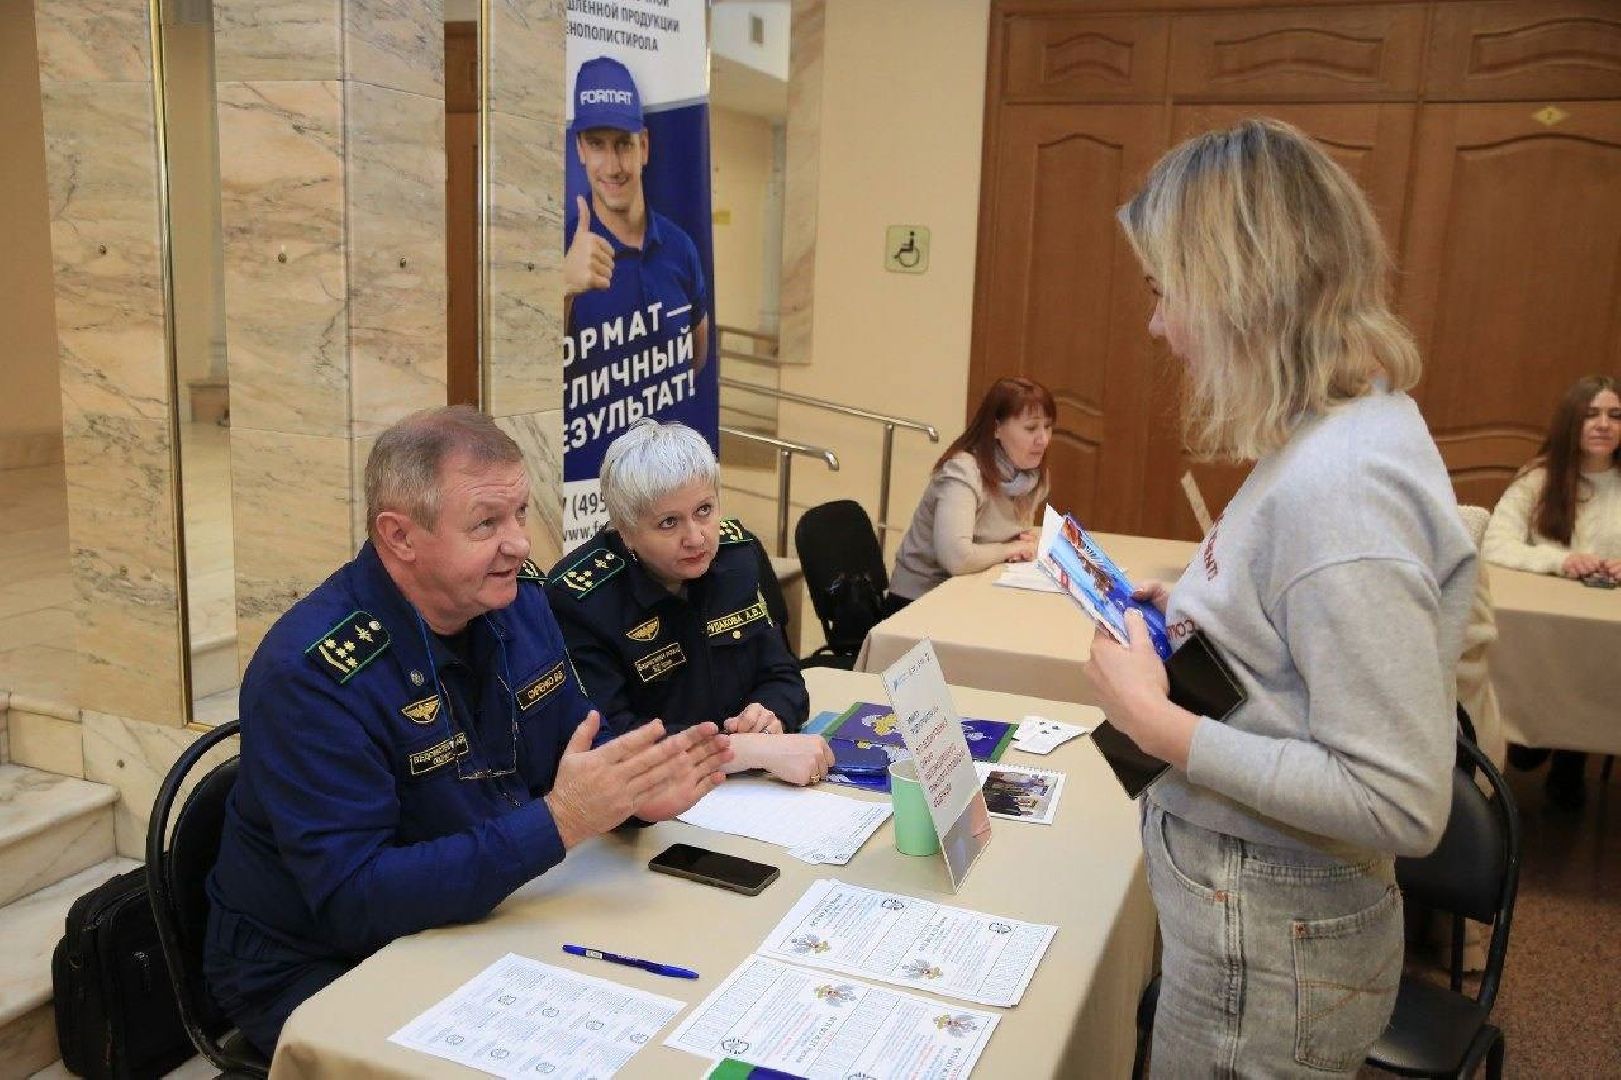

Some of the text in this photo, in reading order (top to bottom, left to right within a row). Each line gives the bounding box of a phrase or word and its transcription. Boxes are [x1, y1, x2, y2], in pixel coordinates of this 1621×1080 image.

[621, 7, 680, 32] ПРОДУКЦИИ
[580, 89, 633, 105] FORMAT
[563, 325, 694, 410] ЛИЧНЫЙ
